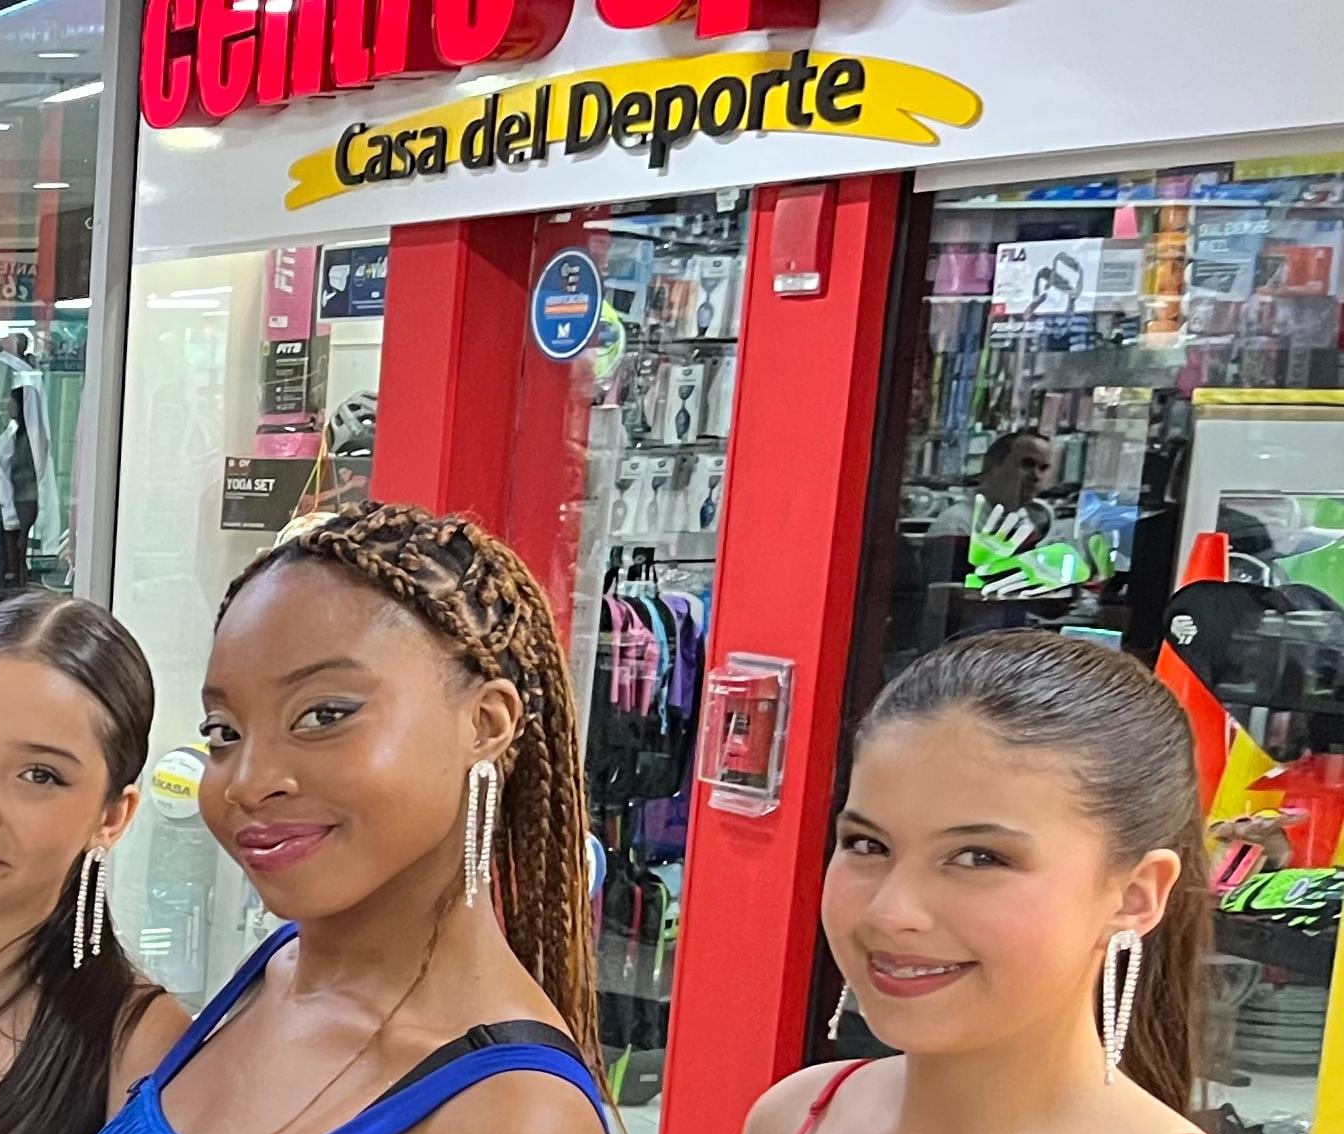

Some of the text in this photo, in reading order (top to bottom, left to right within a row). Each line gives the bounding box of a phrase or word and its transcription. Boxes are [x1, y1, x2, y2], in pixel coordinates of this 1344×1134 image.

[334, 49, 866, 186] Casa del Deporte
[1000, 247, 1026, 262] FILA
[227, 478, 275, 491] YOGA SET
